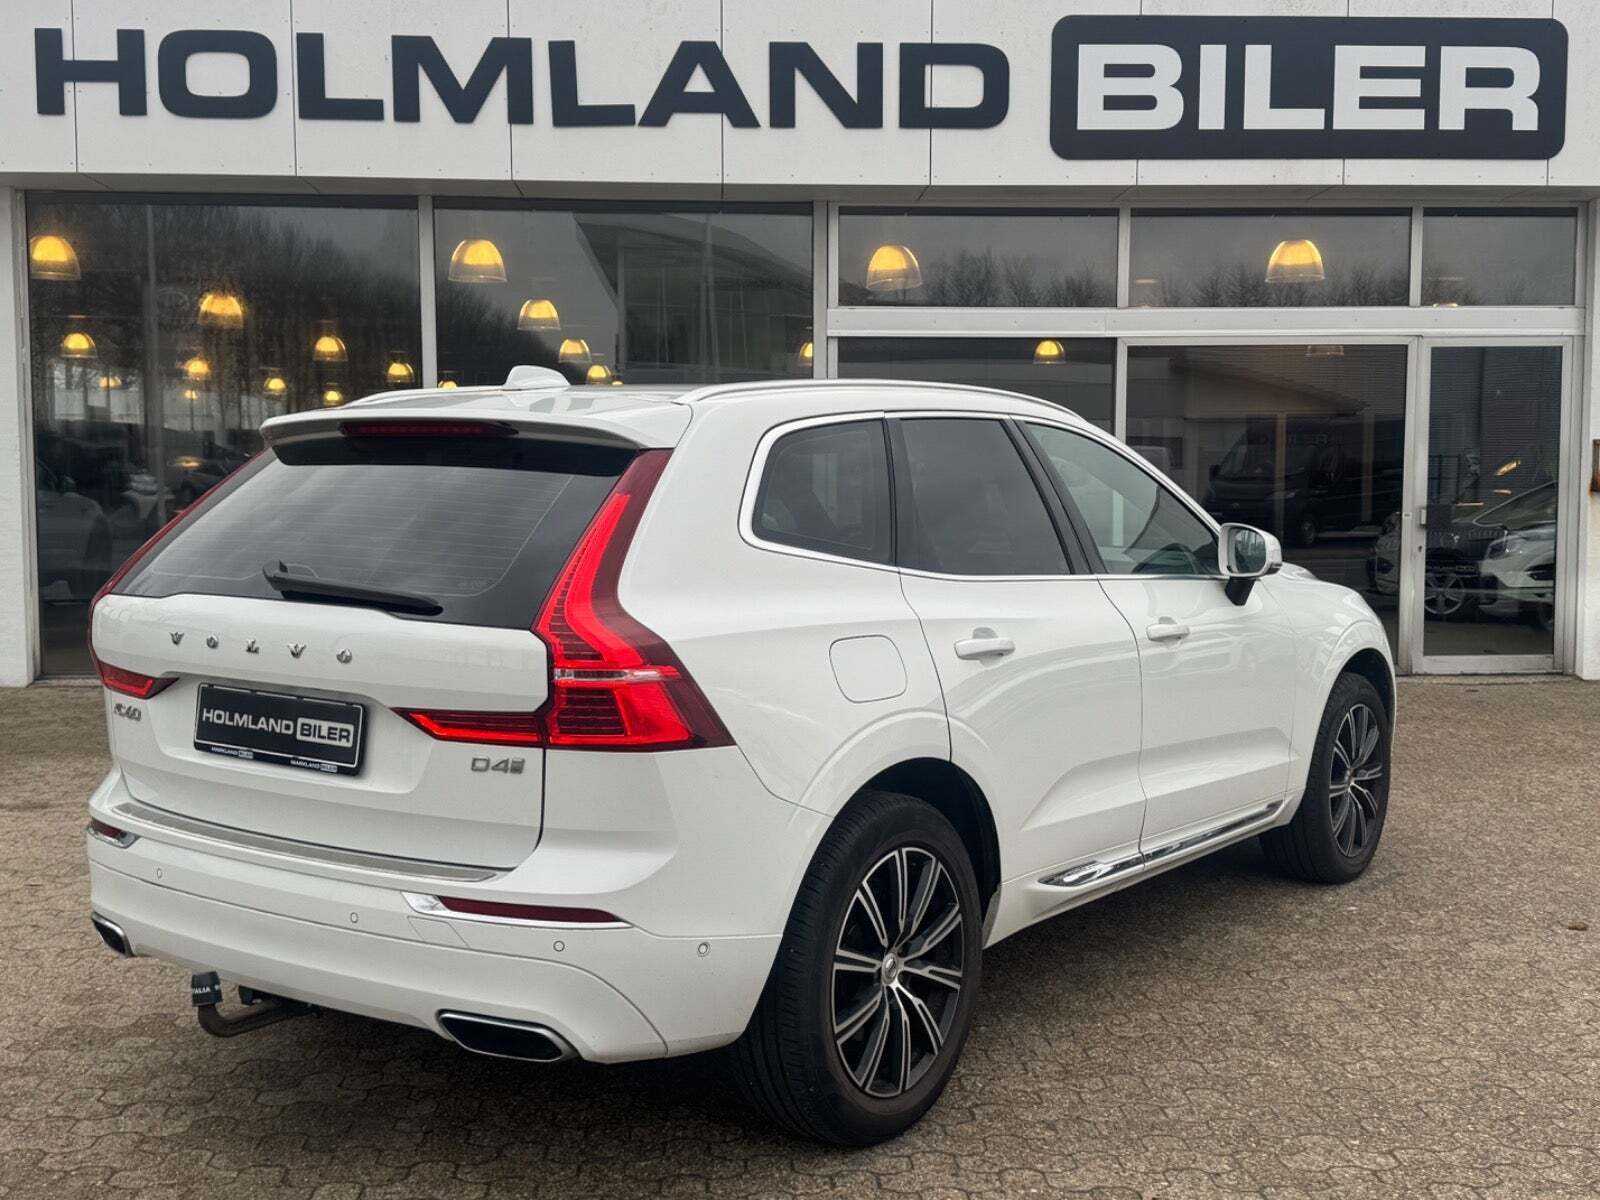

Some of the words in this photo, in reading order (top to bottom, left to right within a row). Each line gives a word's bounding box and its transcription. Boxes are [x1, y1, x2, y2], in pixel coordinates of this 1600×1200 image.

[35, 28, 1009, 129] HOLMLAND
[1077, 44, 1540, 131] BILER
[170, 631, 353, 664] VOLVO
[202, 707, 294, 735] HOLMLAND
[301, 723, 351, 743] BILER
